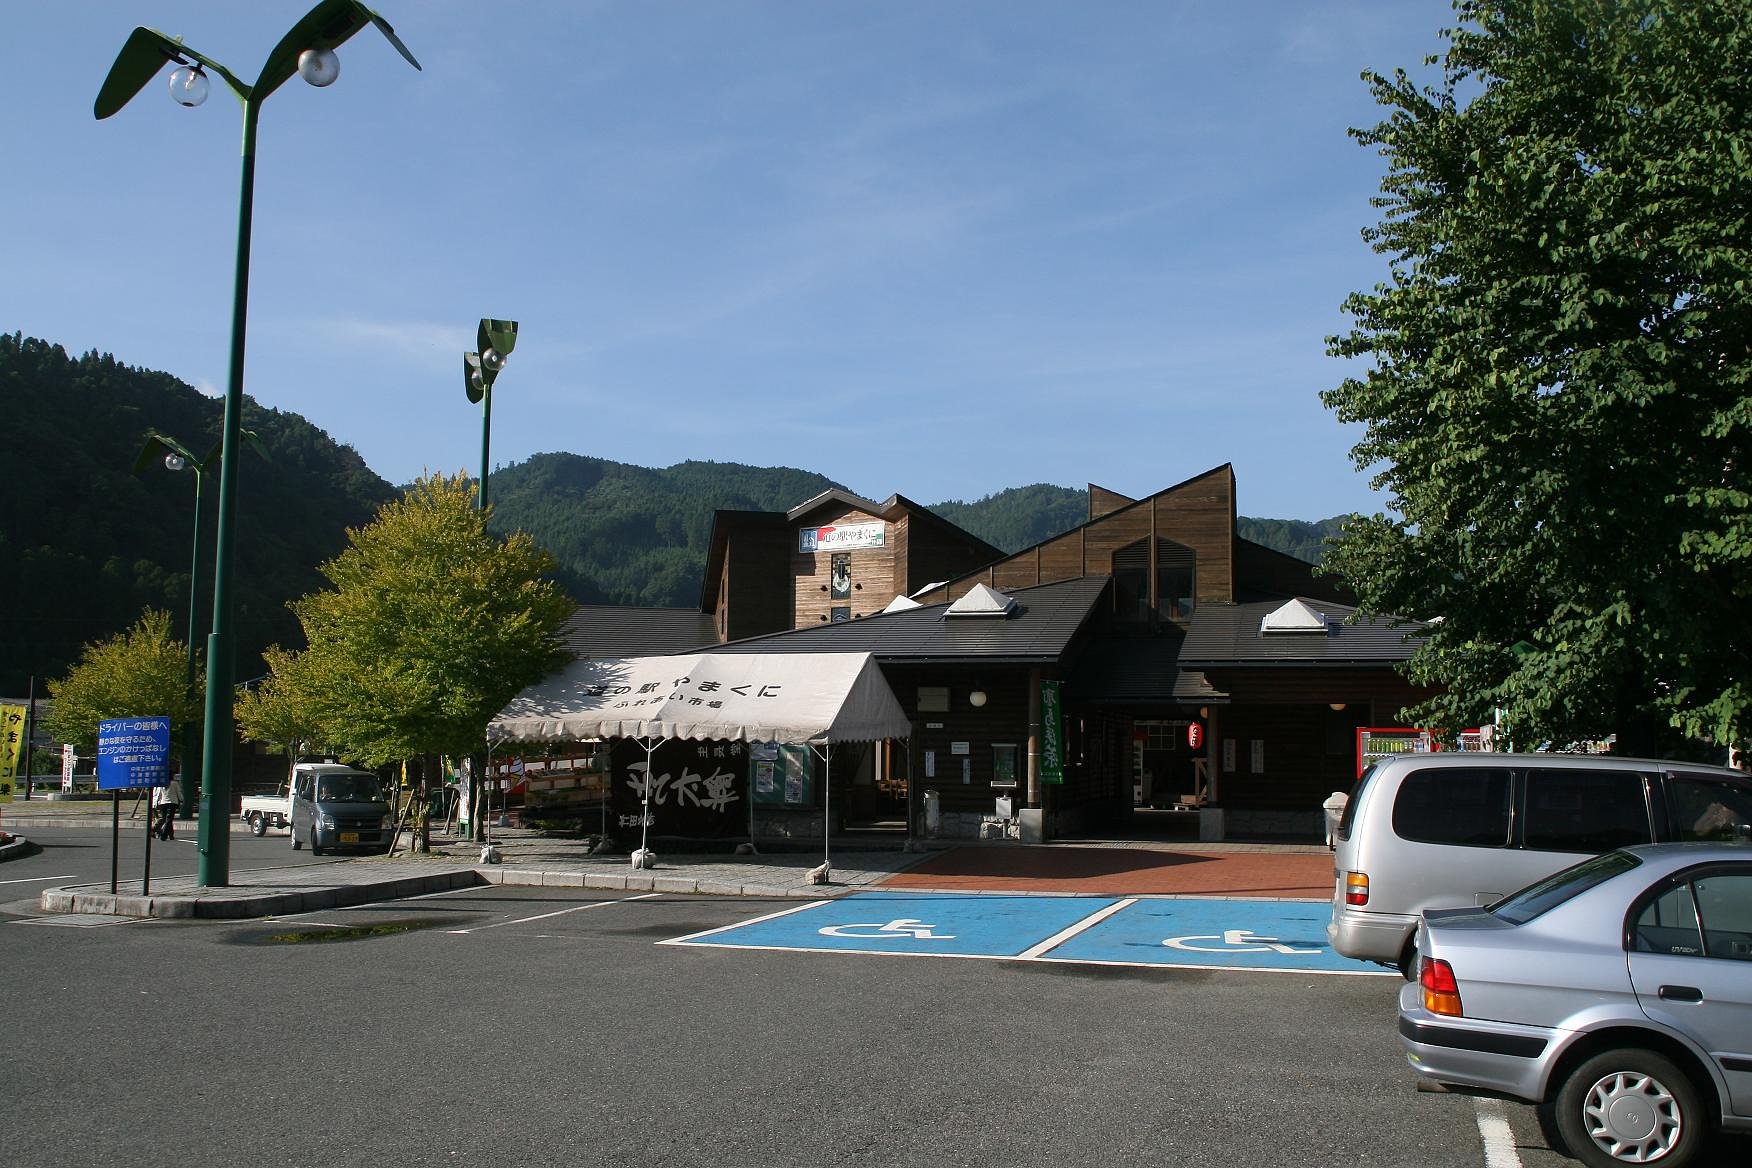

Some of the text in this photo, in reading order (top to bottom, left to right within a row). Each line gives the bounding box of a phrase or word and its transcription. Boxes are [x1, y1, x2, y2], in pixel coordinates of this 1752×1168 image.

[584, 676, 781, 698] 道の駅やまくに
[613, 692, 723, 709] ふれあい市場
[99, 720, 168, 734] ドライバーの皆様へ
